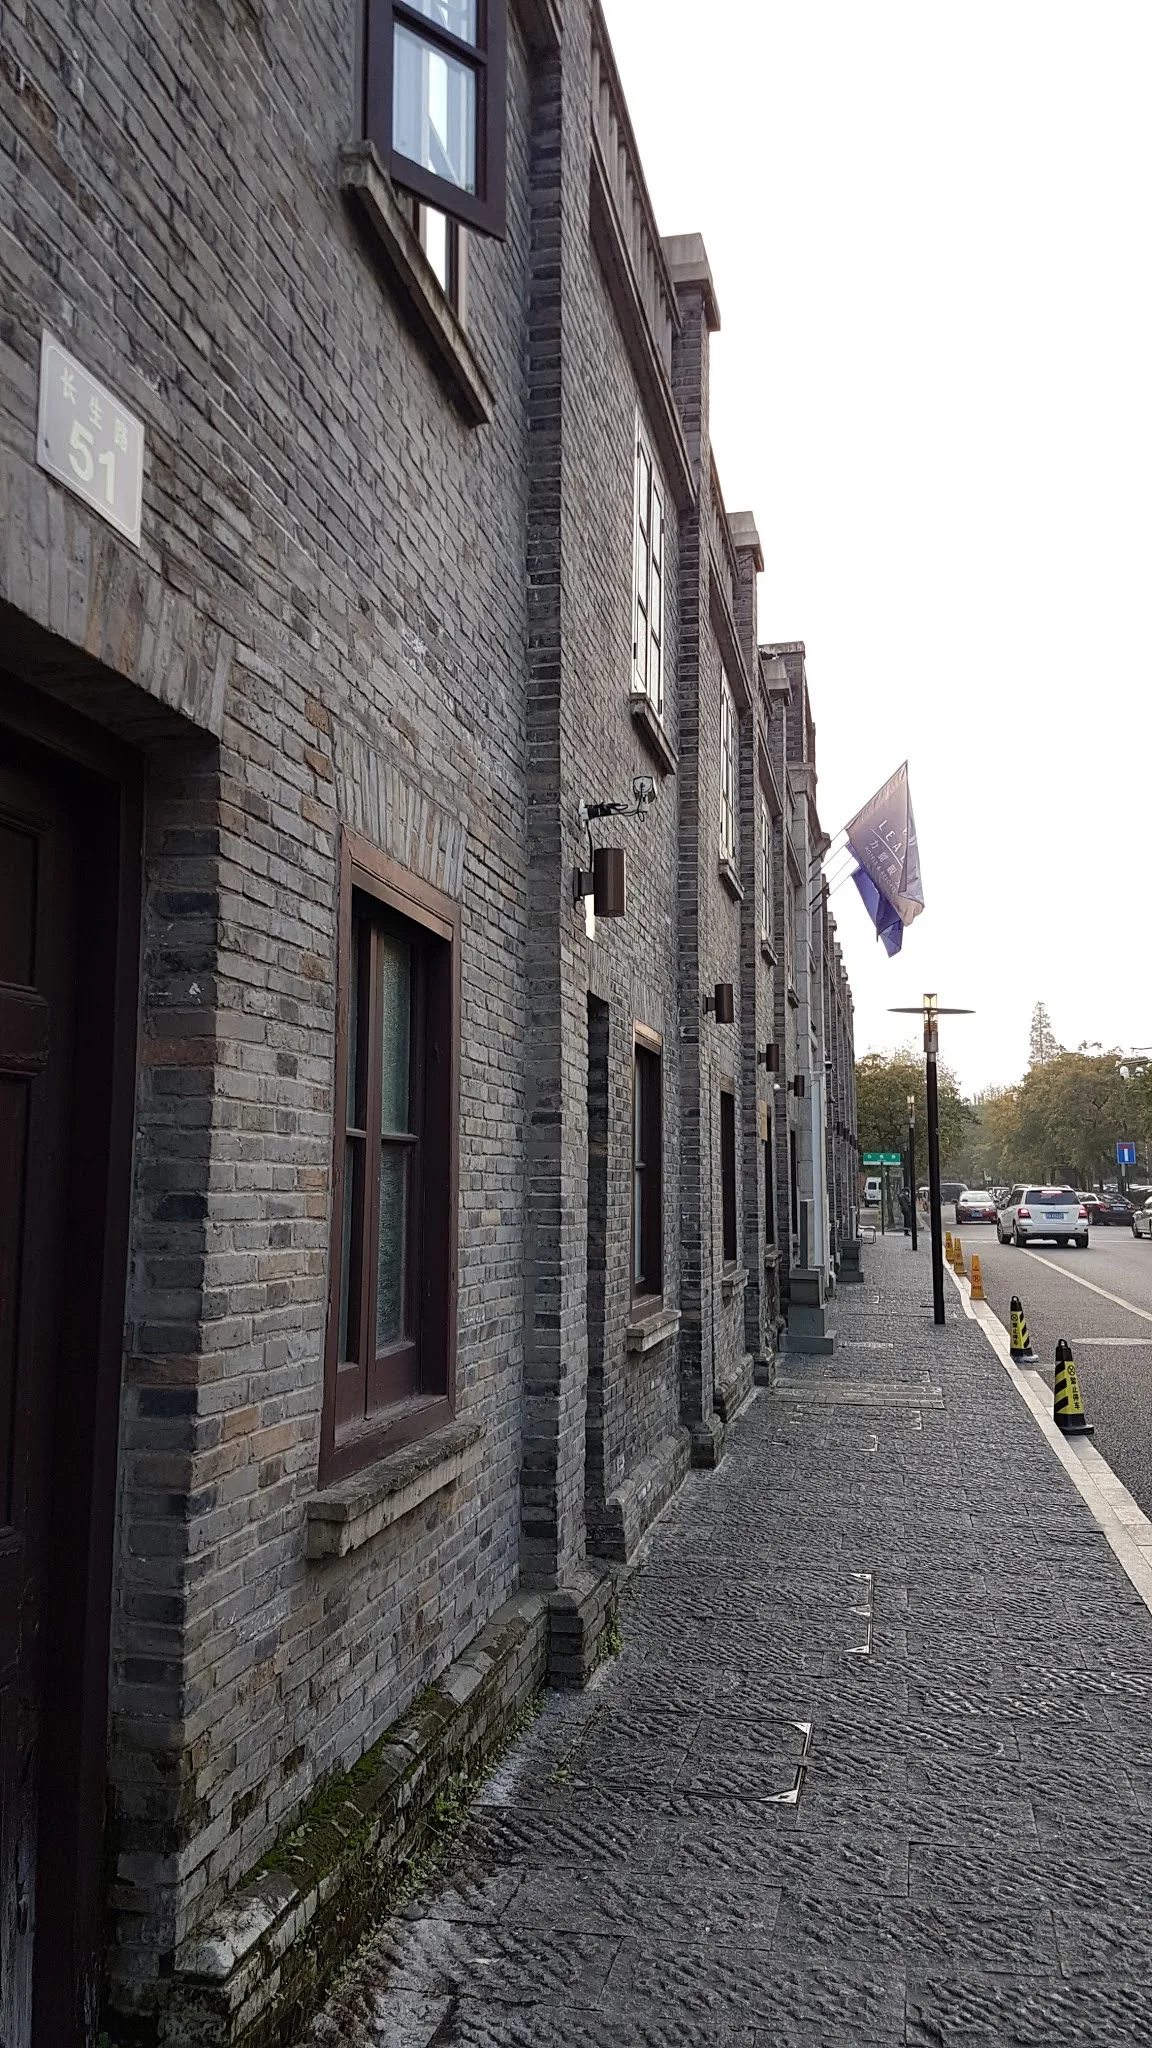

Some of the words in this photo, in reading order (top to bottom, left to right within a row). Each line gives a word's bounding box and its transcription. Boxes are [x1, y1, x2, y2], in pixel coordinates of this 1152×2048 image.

[59, 366, 128, 454] 长生路
[67, 418, 116, 505] 51
[865, 846, 879, 866] HOTELS
[1070, 1376, 1080, 1410] 禁止停车
